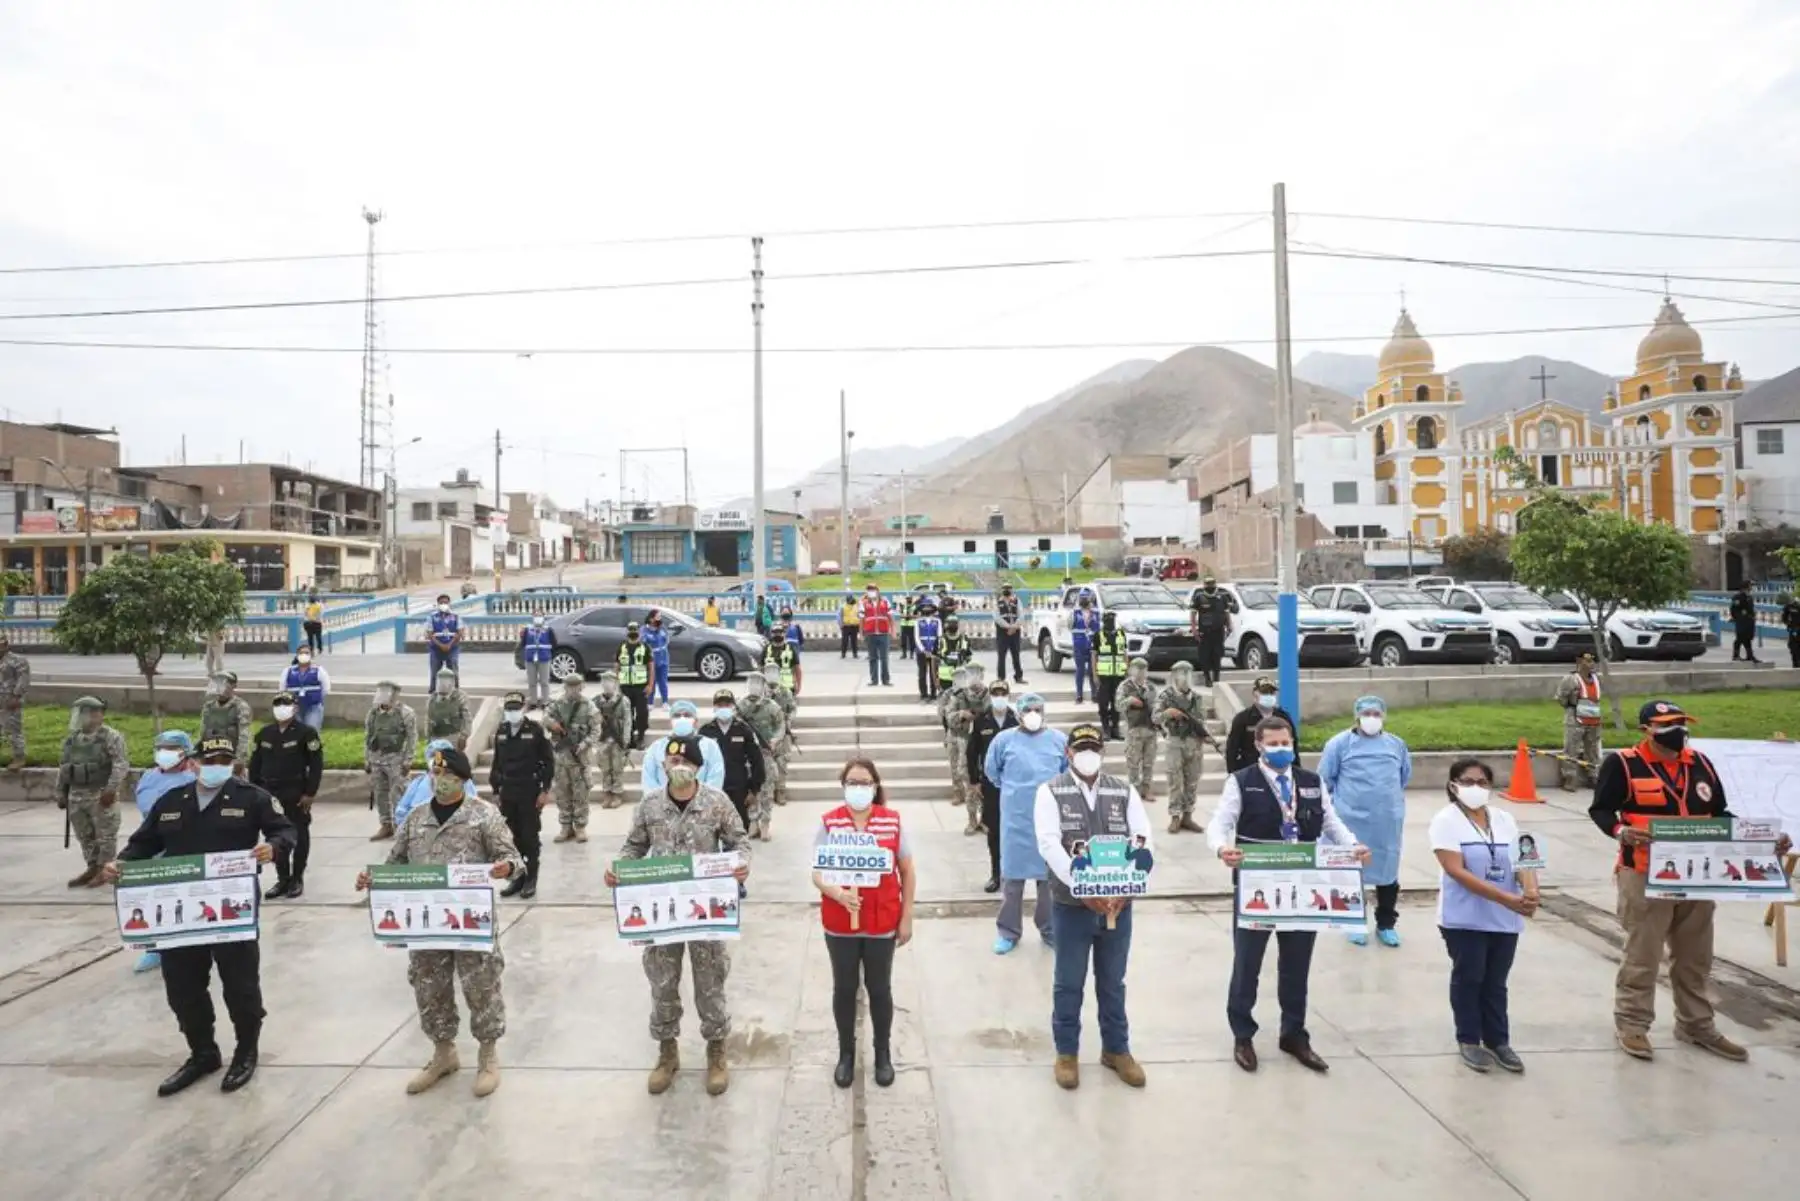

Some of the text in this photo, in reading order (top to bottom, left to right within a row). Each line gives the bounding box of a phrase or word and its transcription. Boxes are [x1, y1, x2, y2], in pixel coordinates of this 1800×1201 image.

[830, 832, 875, 846] MINSA
[818, 855, 886, 868] DE TODOS
[1132, 872, 1145, 881] tu
[1072, 882, 1147, 896] distancia!
